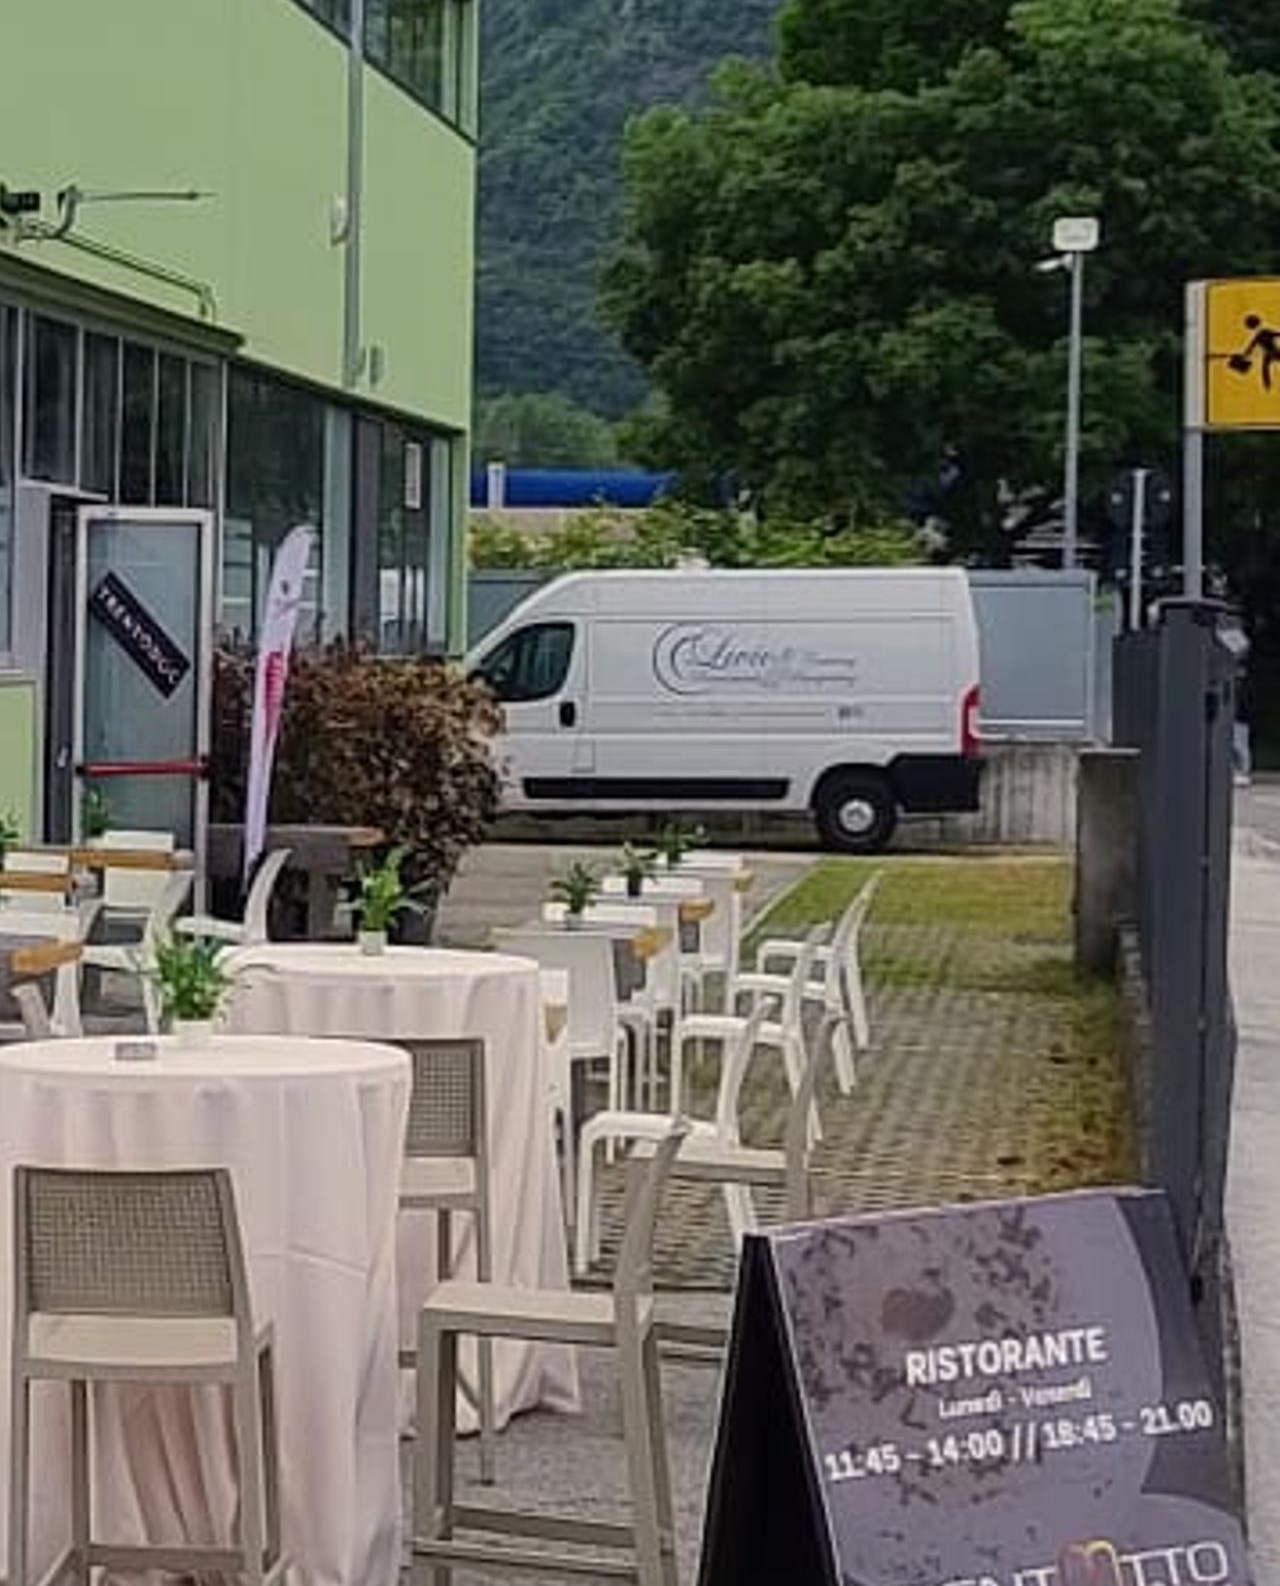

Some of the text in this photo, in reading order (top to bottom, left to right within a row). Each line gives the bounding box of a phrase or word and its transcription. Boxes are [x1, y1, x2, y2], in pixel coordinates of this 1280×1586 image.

[905, 1326, 1108, 1386] RISTORANTE
[825, 1443, 901, 1482] 11:45
[929, 1427, 1003, 1467] 14:00
[1042, 1414, 1117, 1450] 18:45
